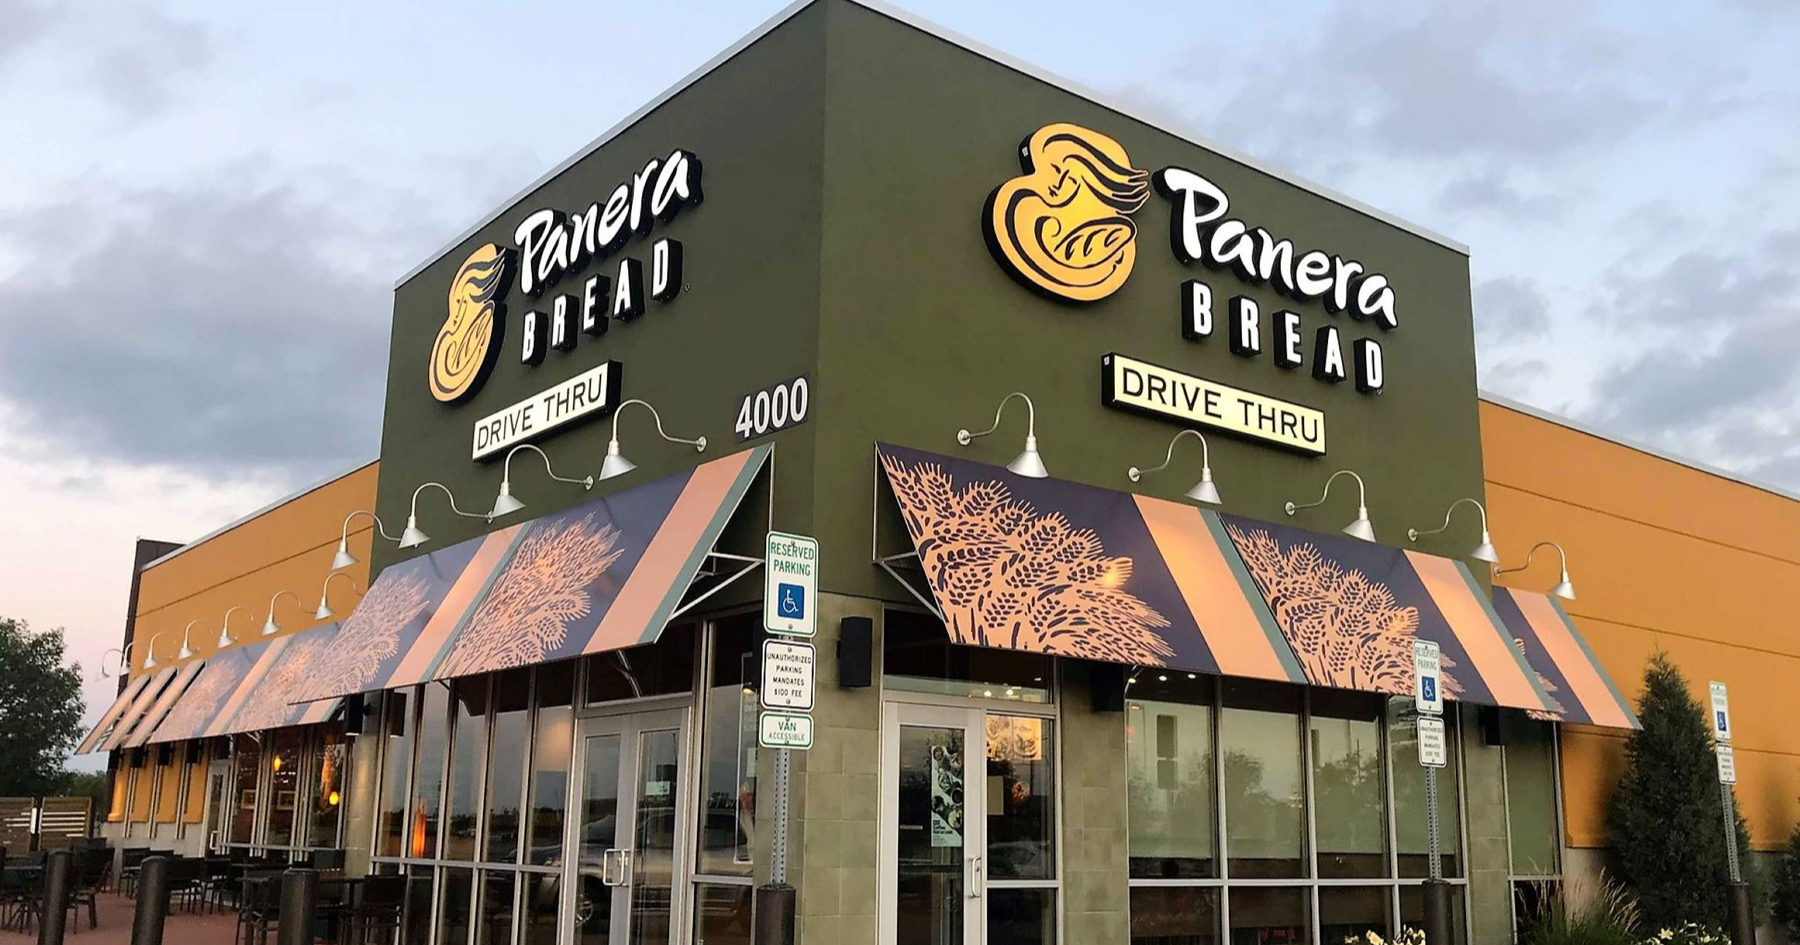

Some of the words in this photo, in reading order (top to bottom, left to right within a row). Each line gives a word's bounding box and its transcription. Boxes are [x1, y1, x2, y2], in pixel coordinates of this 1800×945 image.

[514, 148, 691, 294] Panera
[1162, 166, 1399, 328] Panera
[521, 237, 671, 364] BREAD
[1192, 281, 1383, 389] BREAD
[476, 404, 533, 451] DRIVE
[544, 373, 603, 422] THRU
[734, 376, 809, 439] 4000
[1121, 367, 1223, 419] DRIVE
[1236, 398, 1319, 444] THRU
[770, 541, 815, 560] RESERVED
[773, 559, 811, 577] PARKING
[767, 652, 812, 664] UNAUTHORIZED
[776, 664, 803, 675] PARKING
[772, 676, 805, 687] MANDATES
[774, 688, 789, 697] $100
[791, 689, 803, 698] FEE
[778, 721, 797, 732] VAN
[769, 732, 805, 741] ACCESSIBLE
